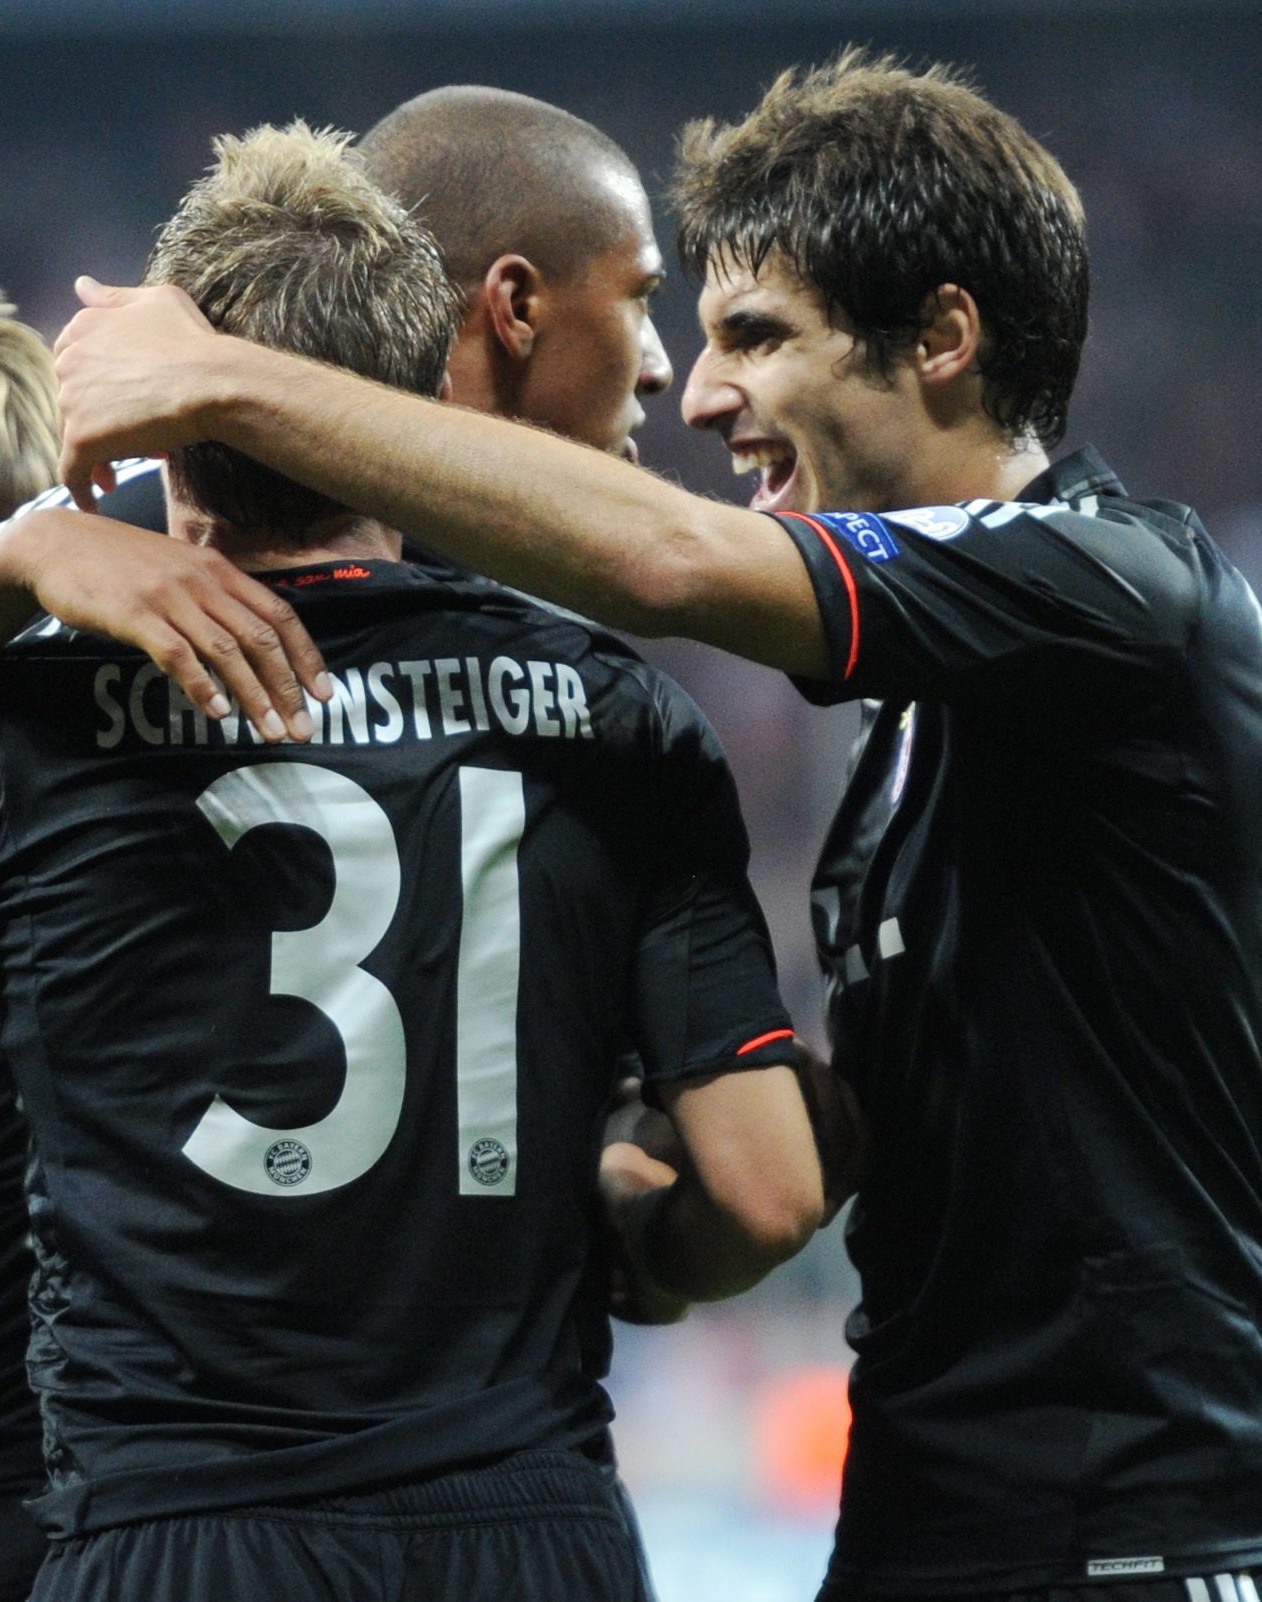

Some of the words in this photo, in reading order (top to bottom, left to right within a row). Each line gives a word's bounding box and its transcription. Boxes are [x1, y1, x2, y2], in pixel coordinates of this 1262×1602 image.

[831, 512, 889, 559] PECT
[94, 656, 596, 749] SCHINSTEIGER
[182, 761, 525, 1197] 31
[277, 1142, 308, 1161] BAYERN
[1091, 1560, 1161, 1572] TECHFIT
